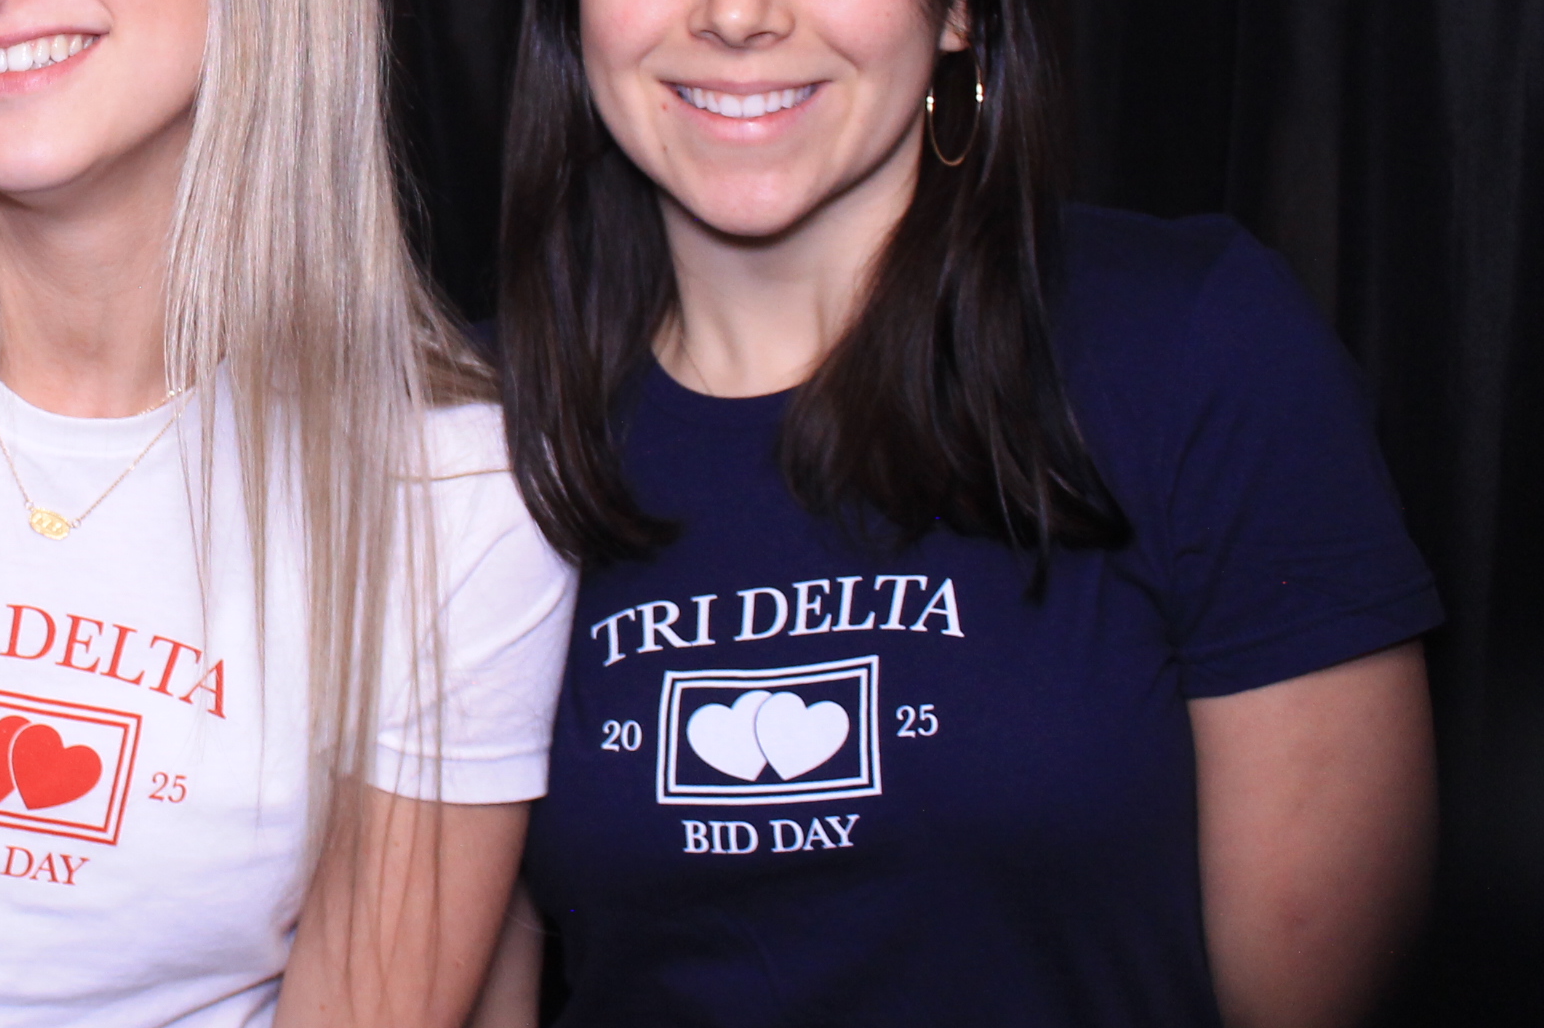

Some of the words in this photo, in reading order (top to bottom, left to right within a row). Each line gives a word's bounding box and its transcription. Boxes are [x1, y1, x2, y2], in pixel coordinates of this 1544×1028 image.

[591, 595, 718, 667] TRI
[733, 574, 965, 640] DELTA
[0, 604, 227, 719] DELTA
[601, 720, 643, 752] 20
[895, 704, 939, 738] 25
[148, 772, 187, 803] 25
[682, 820, 759, 854] BID
[769, 814, 860, 853] DAY
[0, 846, 90, 885] DAY
